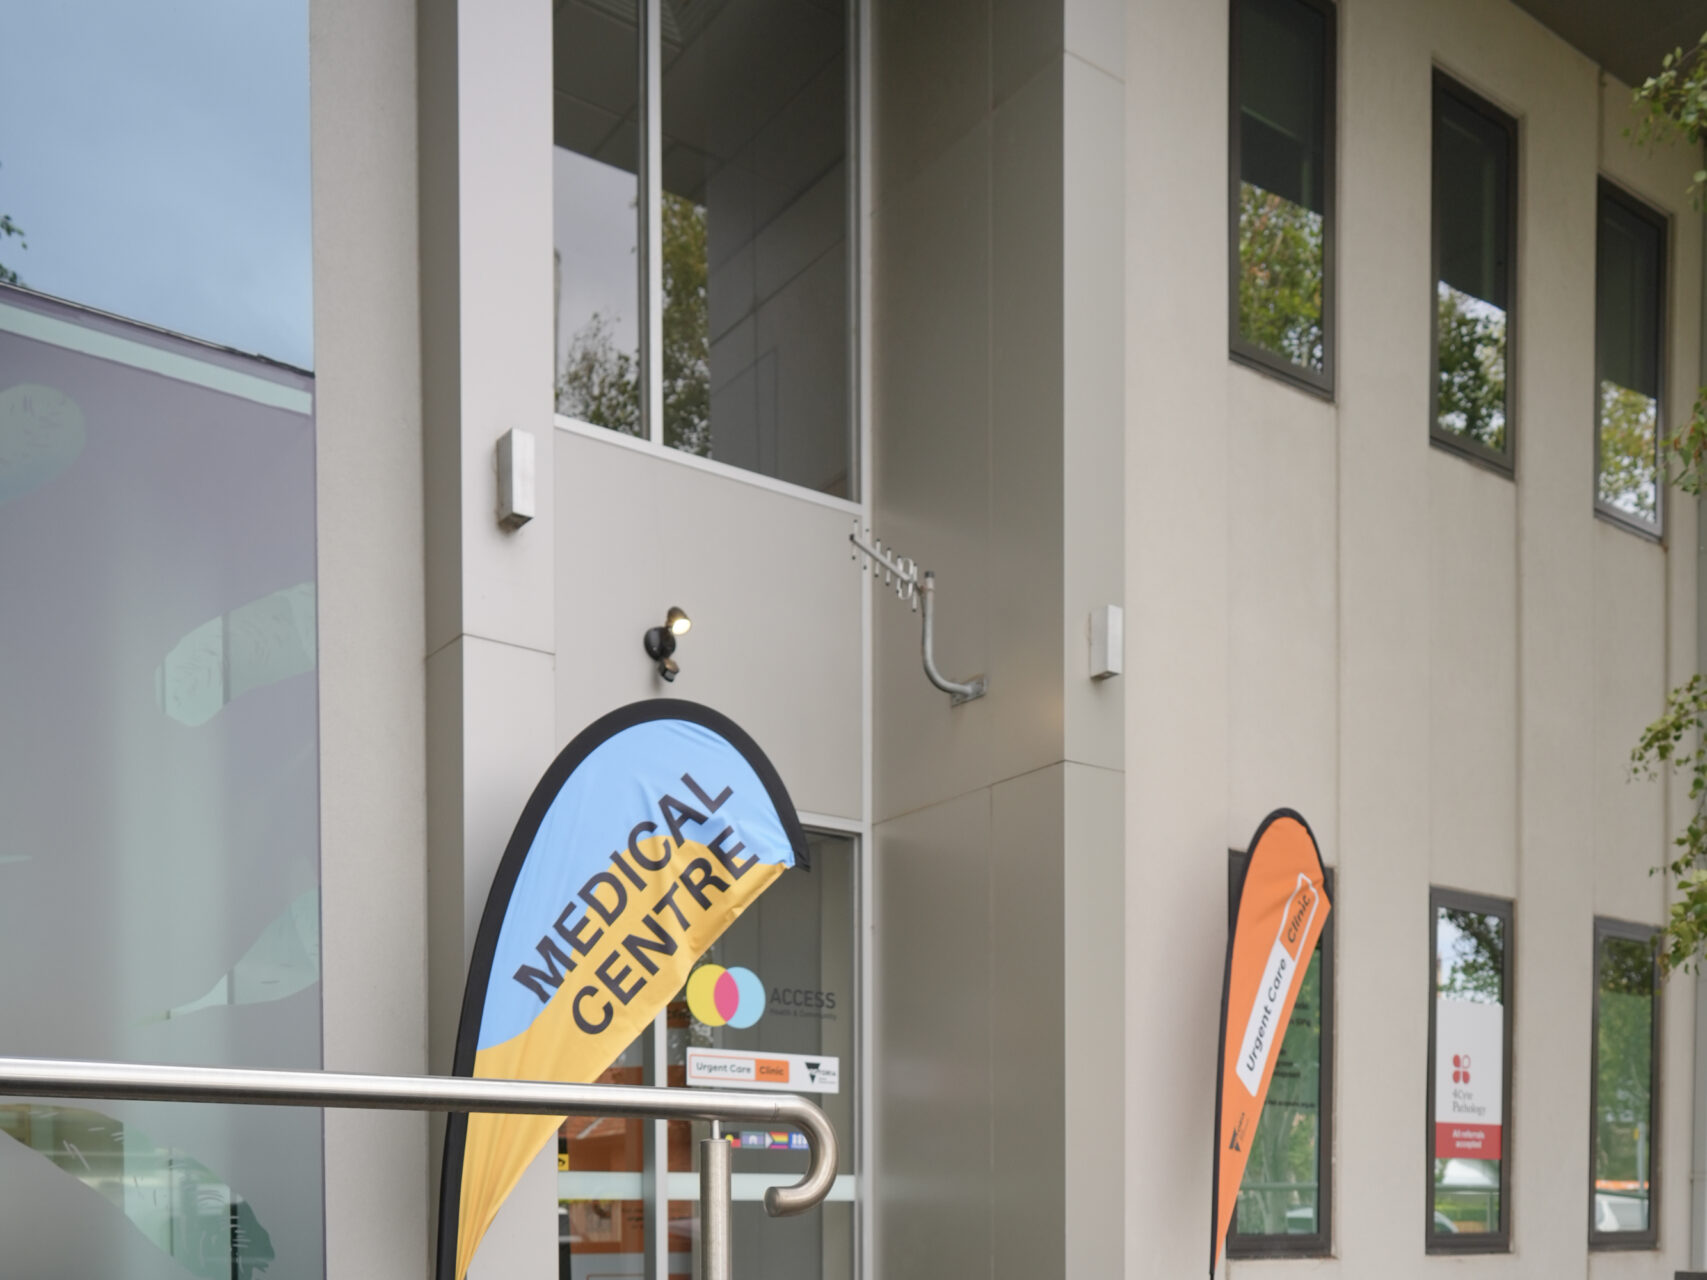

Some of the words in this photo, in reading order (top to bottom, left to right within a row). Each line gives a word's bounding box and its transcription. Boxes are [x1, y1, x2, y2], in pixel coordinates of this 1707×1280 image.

[513, 773, 734, 1004] MEDICAL
[572, 826, 760, 1035] CENTRE
[769, 987, 836, 1009] ACCESS
[1246, 1006, 1272, 1073] Urgent
[1268, 958, 1287, 1003] Care
[1287, 894, 1311, 944] Clinic
[696, 1062, 728, 1074] Urgent
[730, 1064, 752, 1074] Care
[759, 1065, 785, 1076] Clinic
[1452, 1101, 1486, 1116] Pathology
